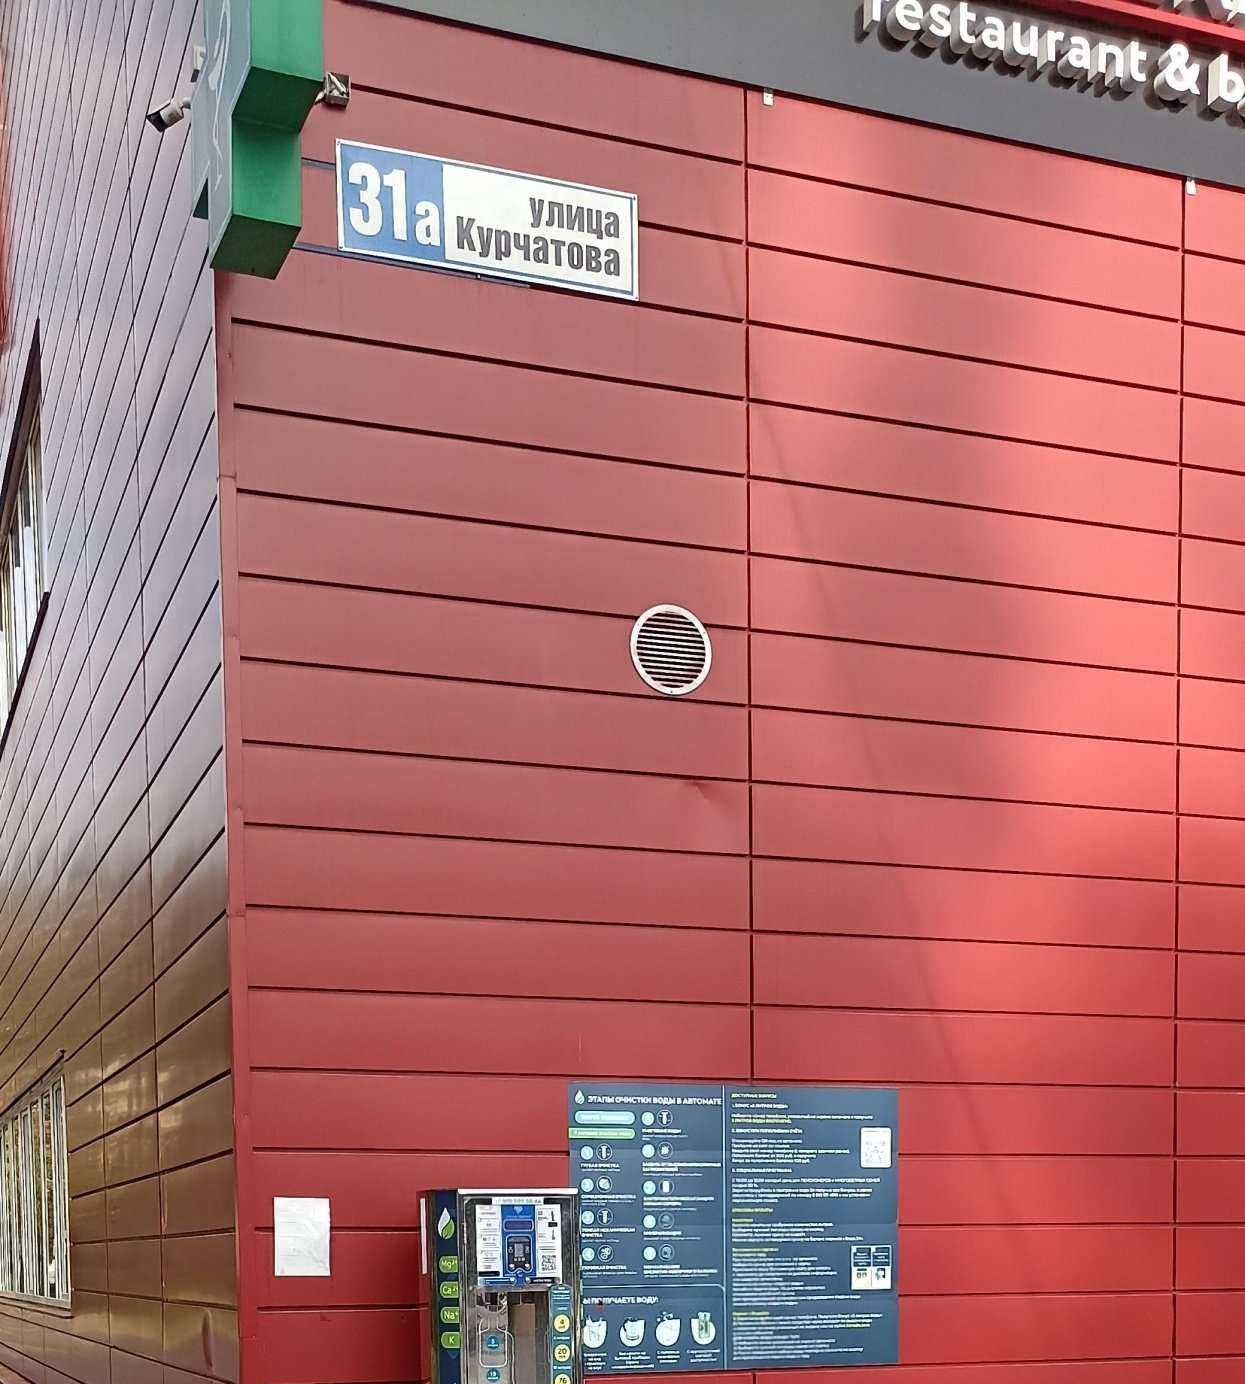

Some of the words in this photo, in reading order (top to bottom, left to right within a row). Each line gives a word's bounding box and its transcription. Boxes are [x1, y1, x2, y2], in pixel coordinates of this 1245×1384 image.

[866, 0, 1147, 84] restaurant
[1158, 43, 1201, 97] &
[348, 161, 441, 247] 31а
[529, 197, 620, 239] улица
[456, 215, 620, 276] Курчатова
[587, 1095, 614, 1103] ЭТАПЫ
[615, 1096, 652, 1104] ОЧИСТКИ
[653, 1097, 676, 1105] ВОДЫ
[683, 1098, 722, 1106] АВТОМАТЕ
